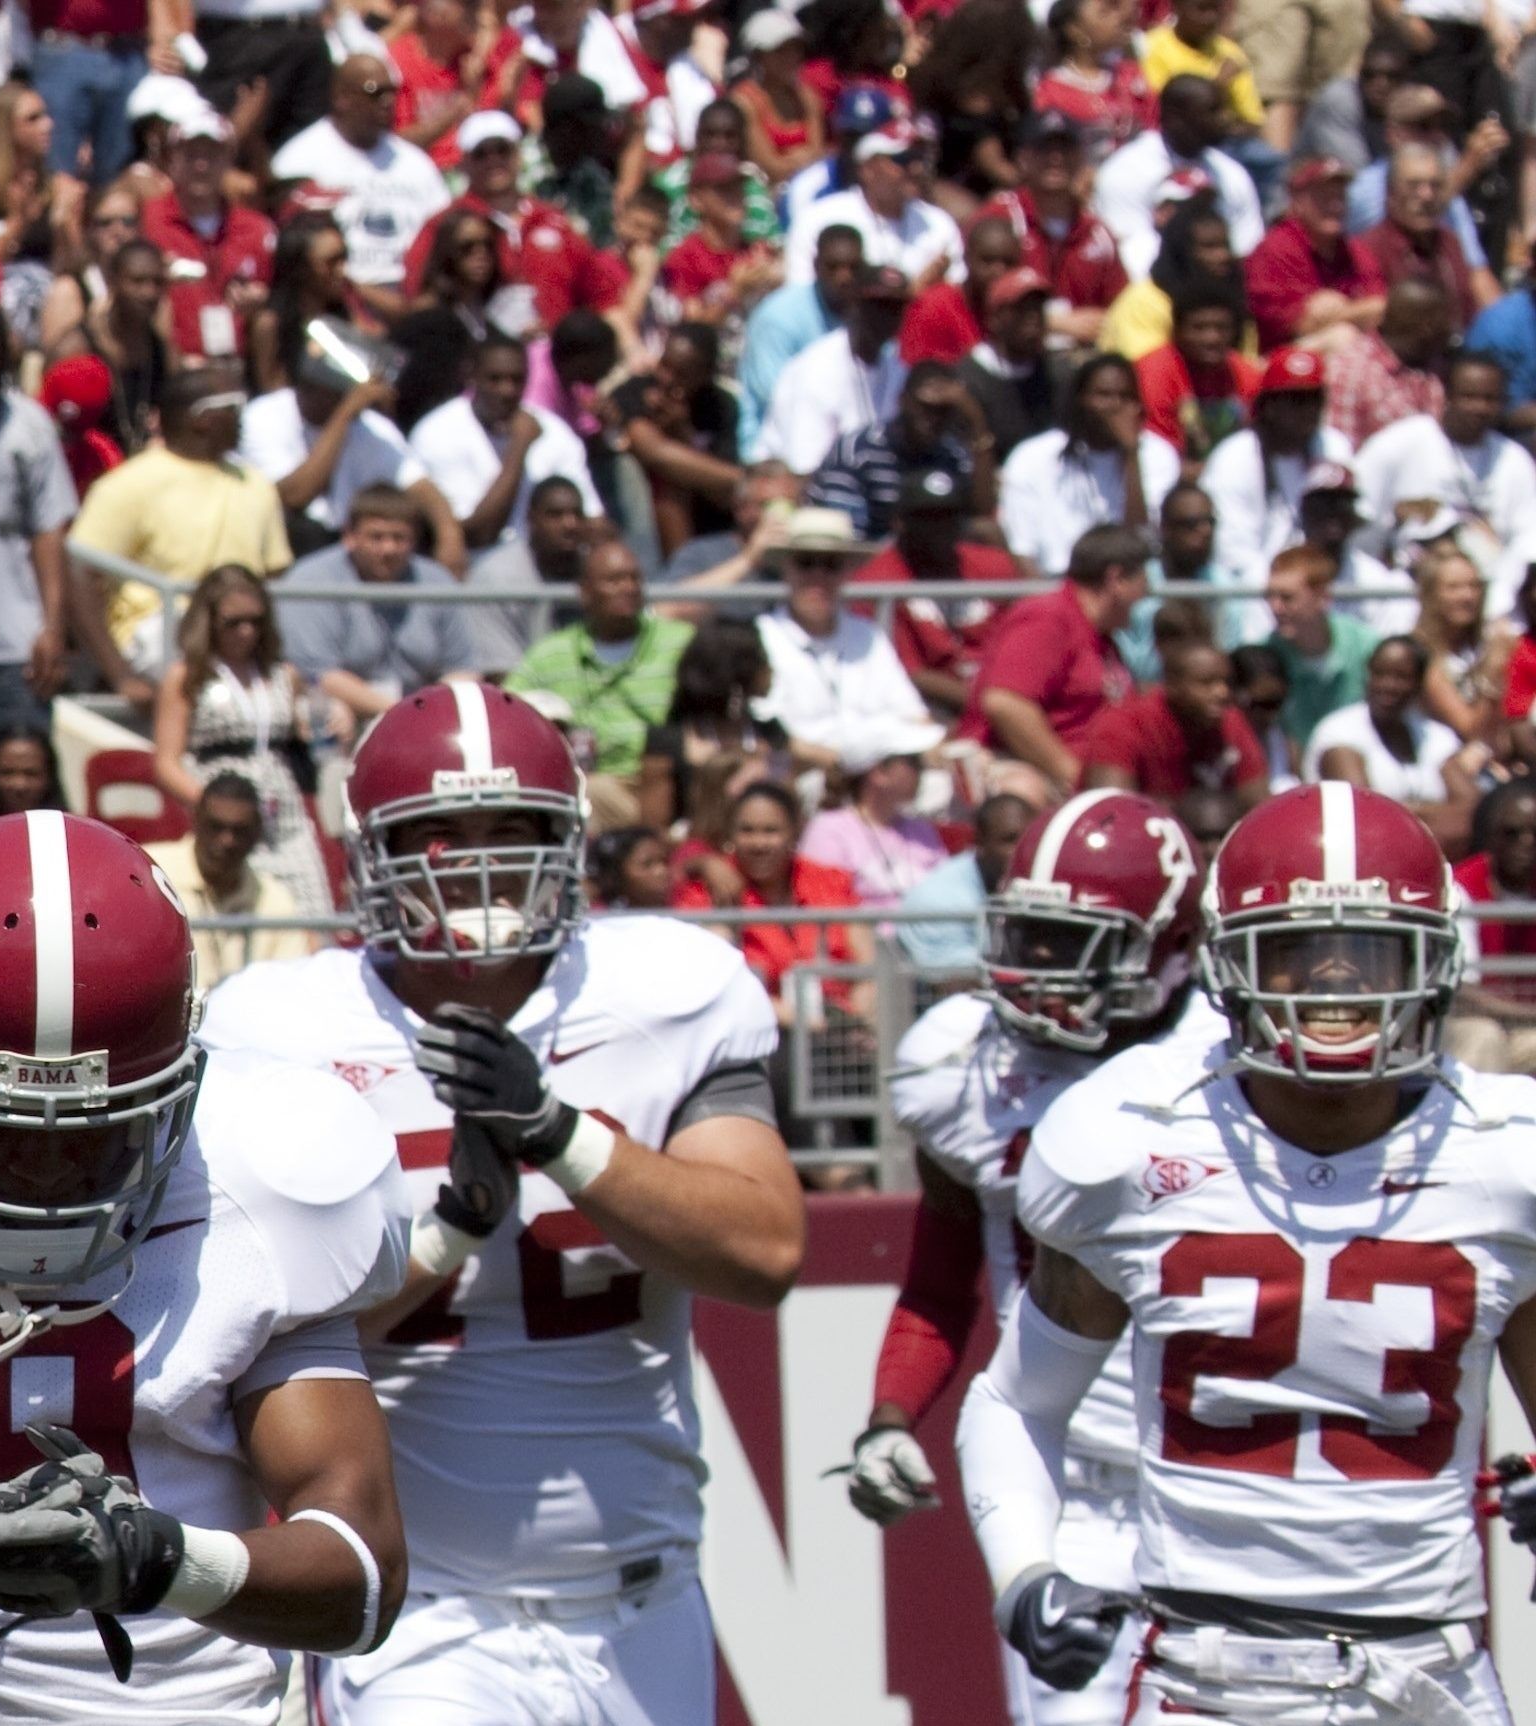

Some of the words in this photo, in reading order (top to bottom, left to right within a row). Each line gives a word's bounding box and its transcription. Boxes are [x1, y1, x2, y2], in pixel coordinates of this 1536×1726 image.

[17, 1068, 77, 1086] BAMA
[1157, 1161, 1191, 1193] SEC
[1161, 1232, 1477, 1481] 23
